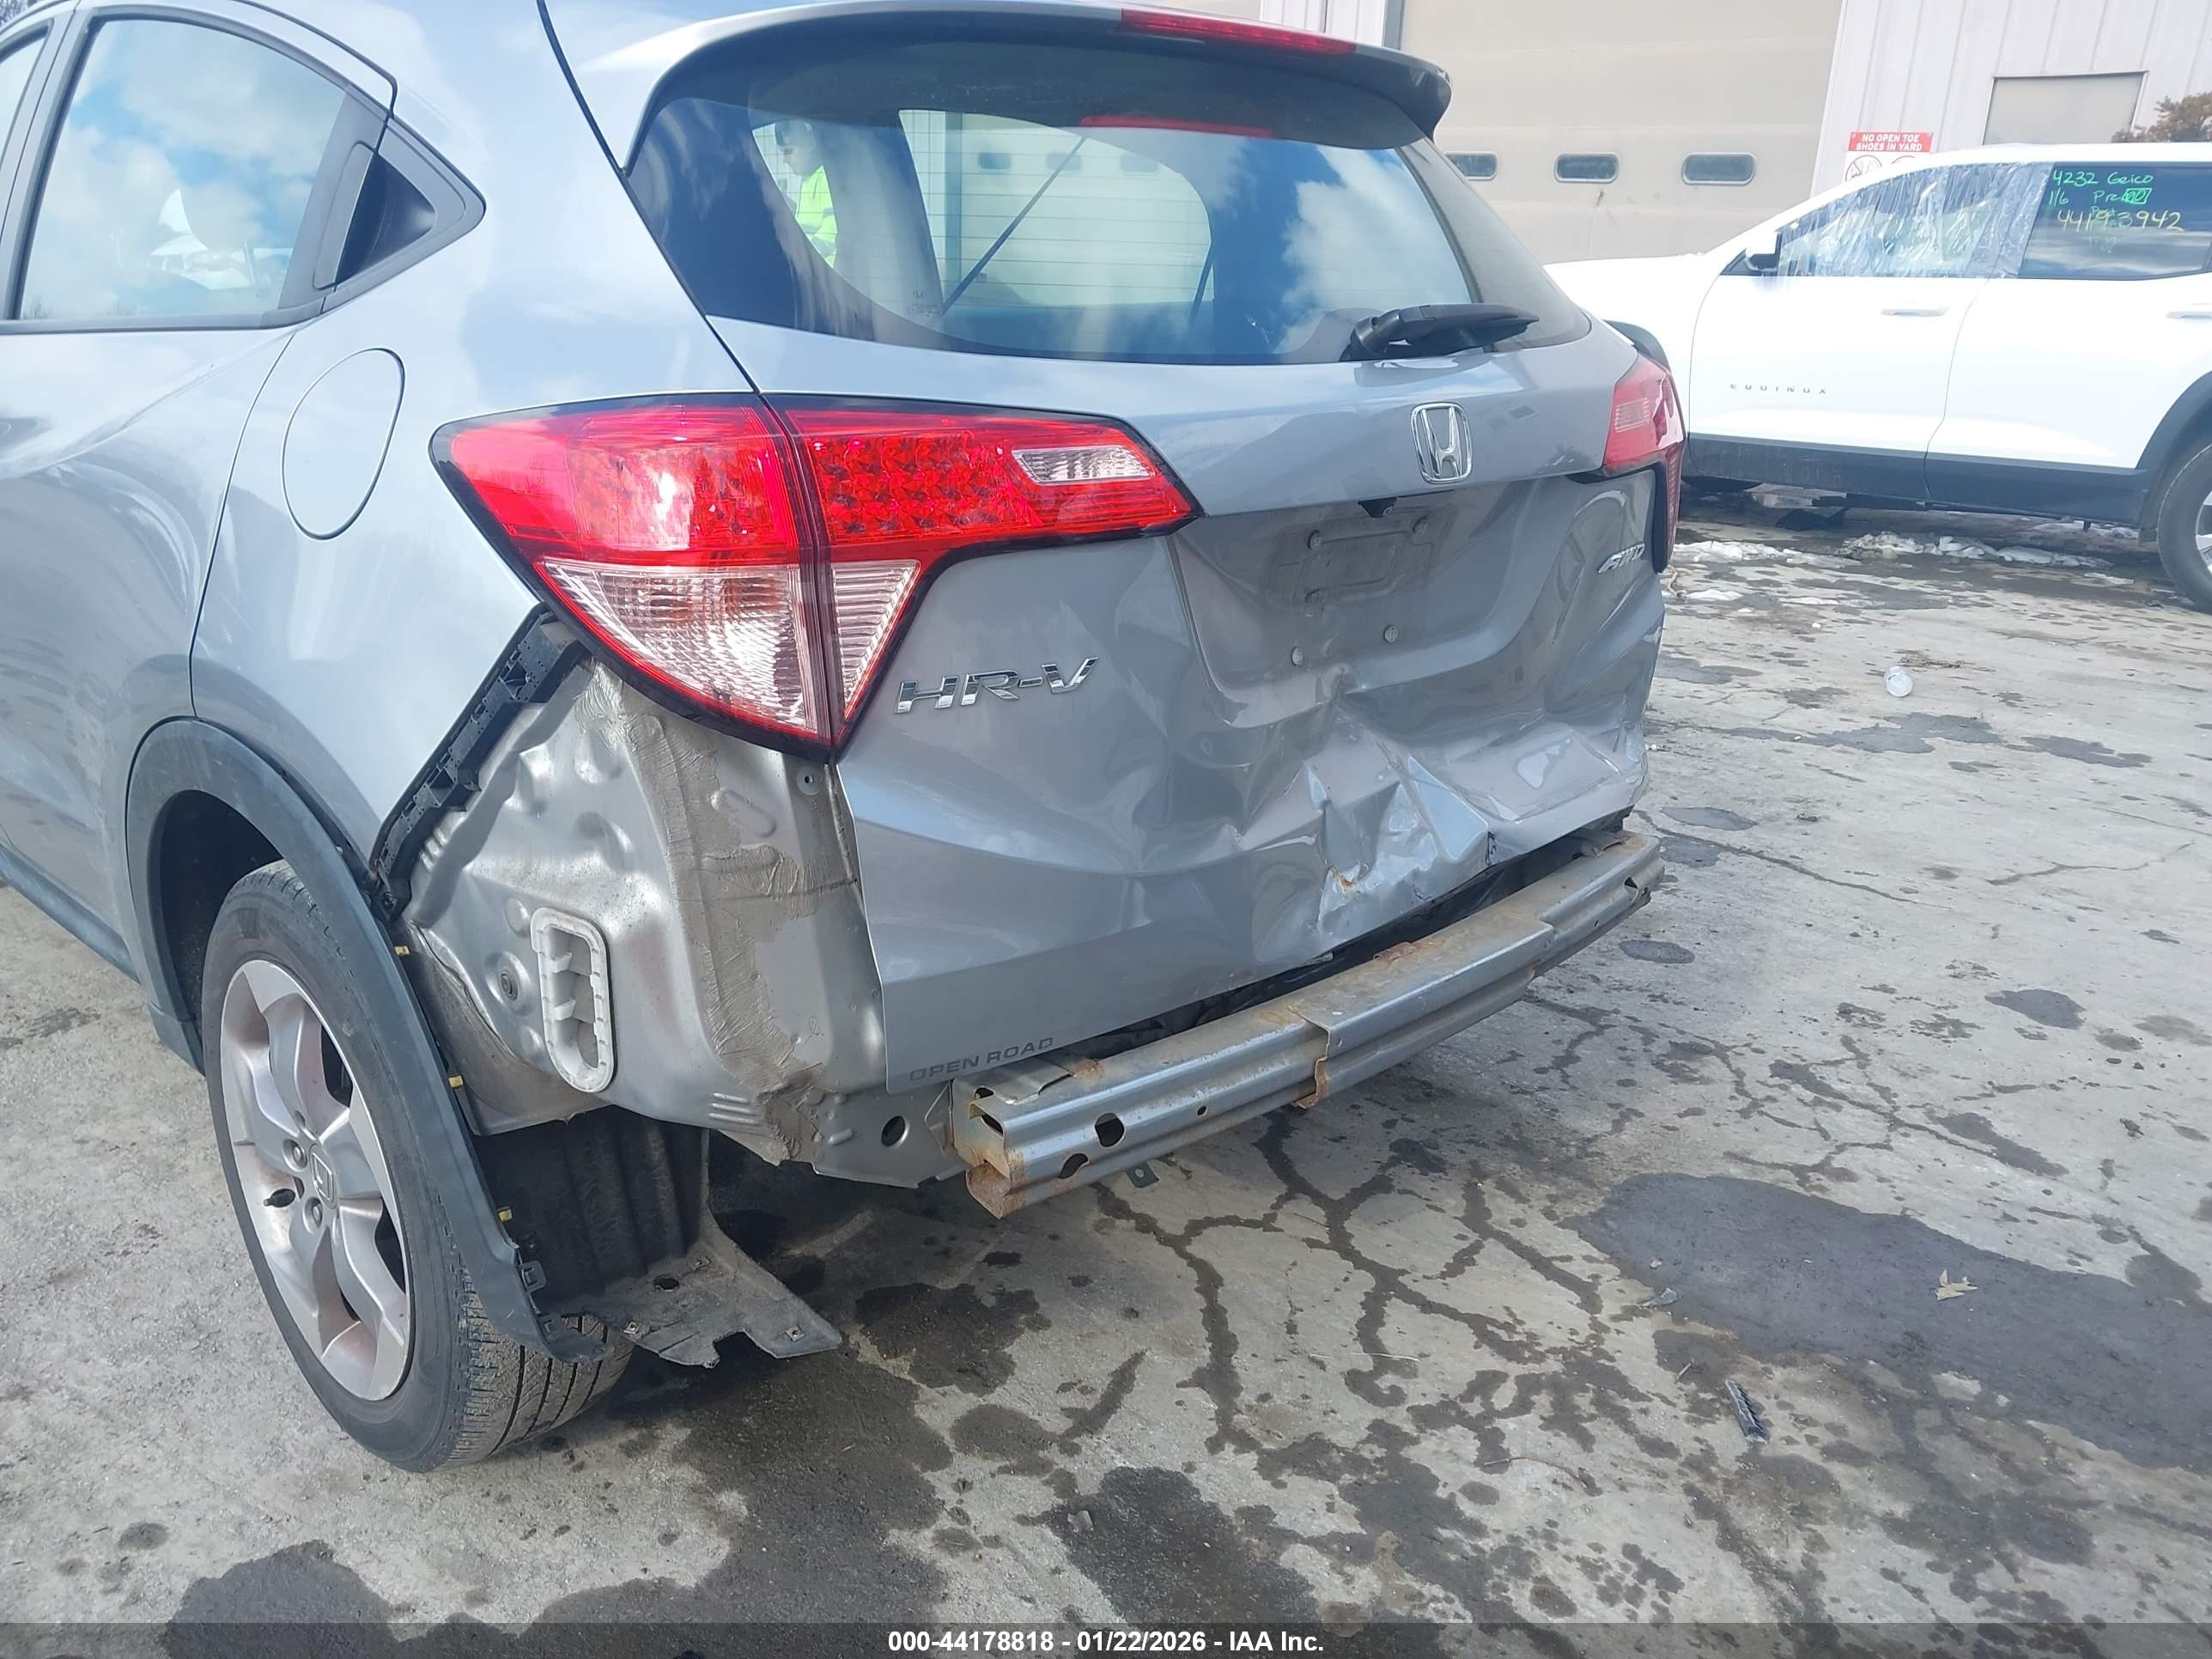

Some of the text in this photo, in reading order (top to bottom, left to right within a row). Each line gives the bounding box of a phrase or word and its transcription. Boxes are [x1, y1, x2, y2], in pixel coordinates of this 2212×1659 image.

[1855, 142, 1923, 152] SHOES IN YARD
[1862, 133, 1920, 143] NO OPEN TOE
[2052, 169, 2100, 187] 4232
[893, 655, 1099, 715] HR-V
[908, 1036, 1054, 1082] OPEN ROAD
